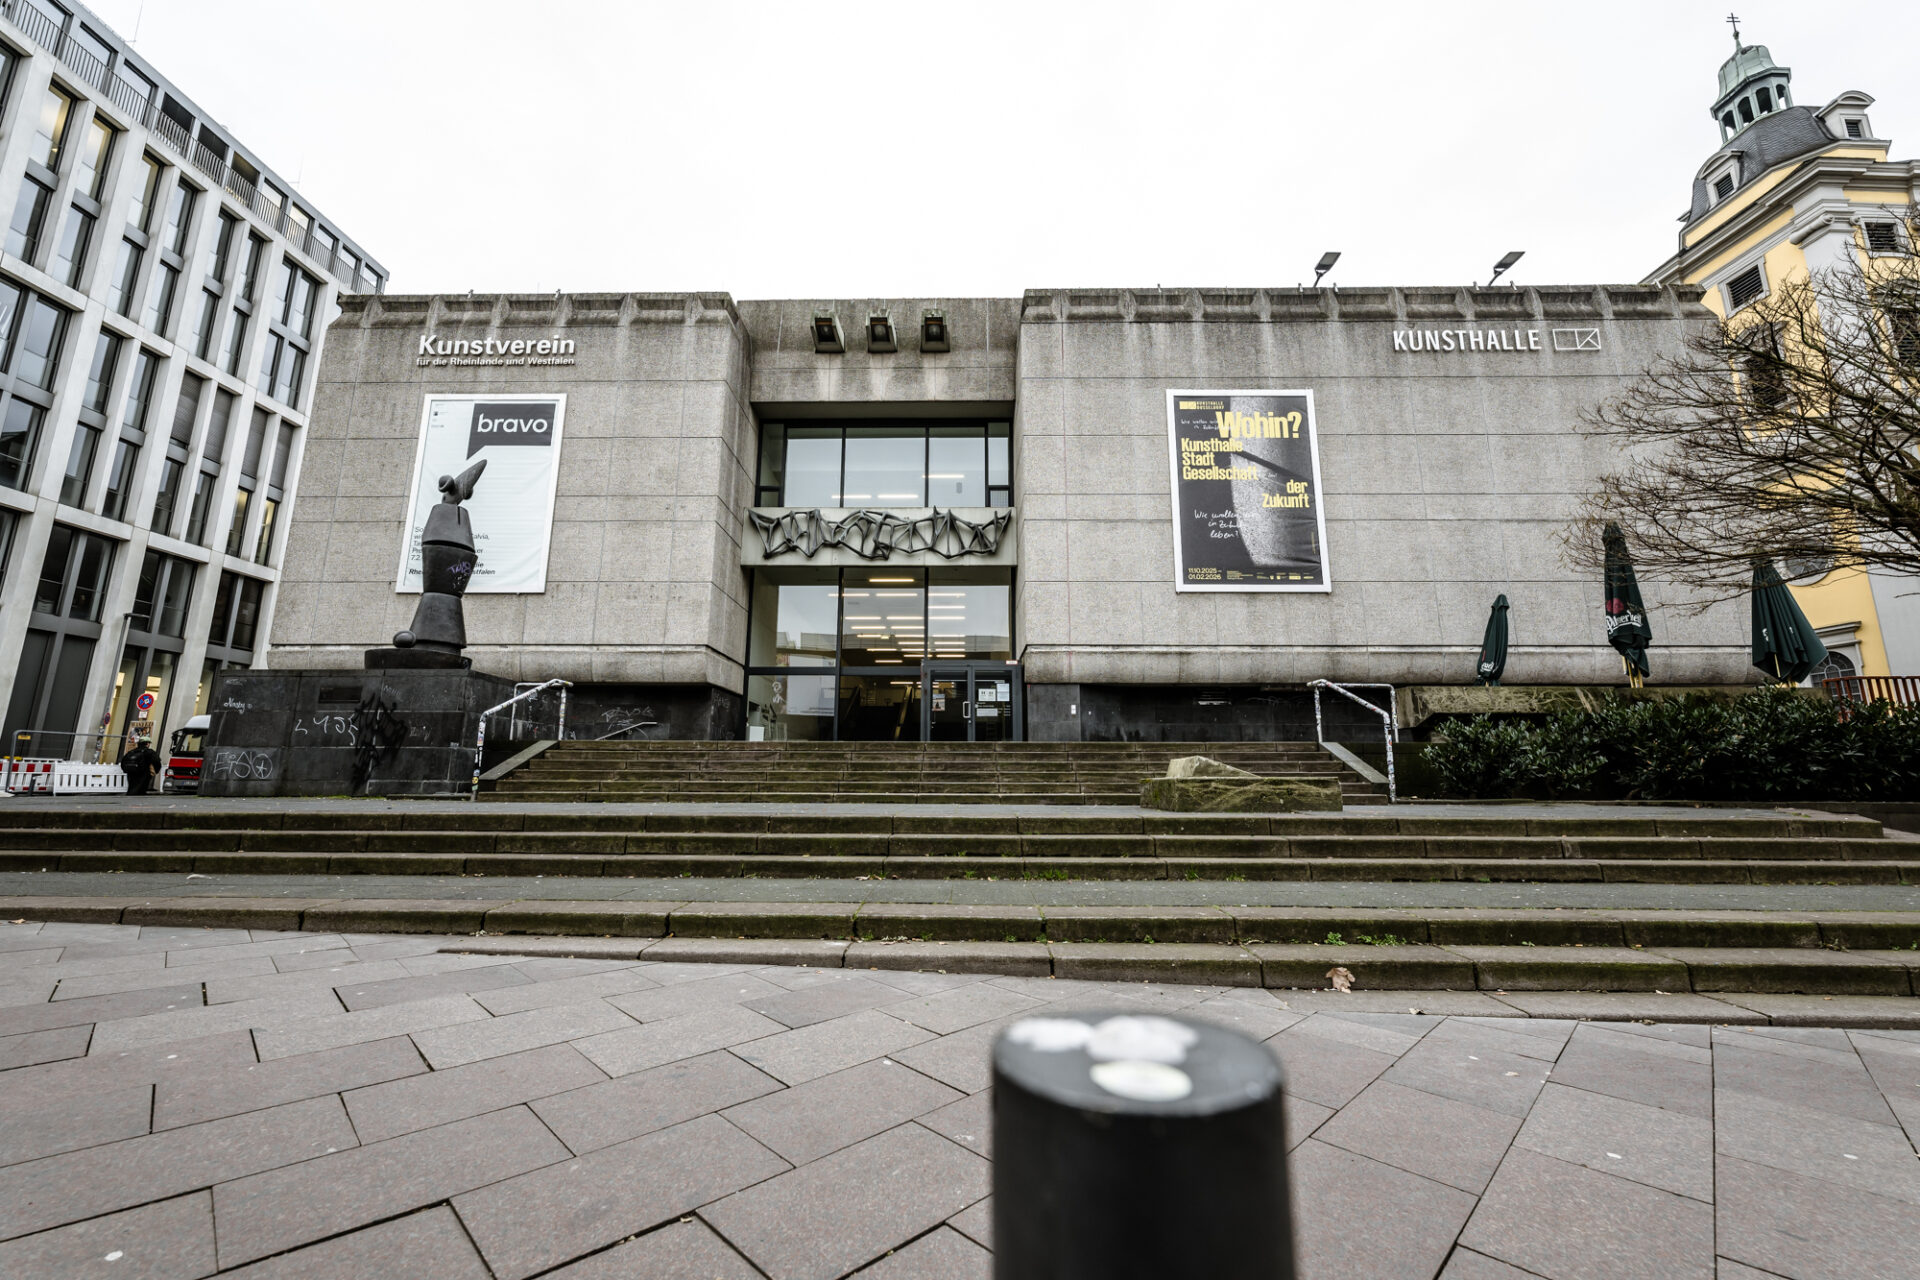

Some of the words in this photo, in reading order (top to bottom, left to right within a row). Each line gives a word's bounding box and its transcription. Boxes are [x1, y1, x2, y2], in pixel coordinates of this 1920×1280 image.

[418, 334, 575, 355] Kunstverein
[1393, 329, 1542, 350] KUNSTHALLE
[416, 357, 430, 366] für
[432, 357, 447, 366] die
[450, 357, 503, 366] Rheinlande
[506, 357, 525, 366] und
[528, 357, 575, 366] Westfalen
[477, 413, 548, 433] bravo
[1215, 411, 1302, 438] Wohin?
[1181, 438, 1243, 451] Kunsthalle
[1182, 453, 1215, 465] Stadt
[1183, 467, 1258, 480] Gesellschaft
[1286, 480, 1308, 493] der
[1262, 494, 1310, 507] Zukunft
